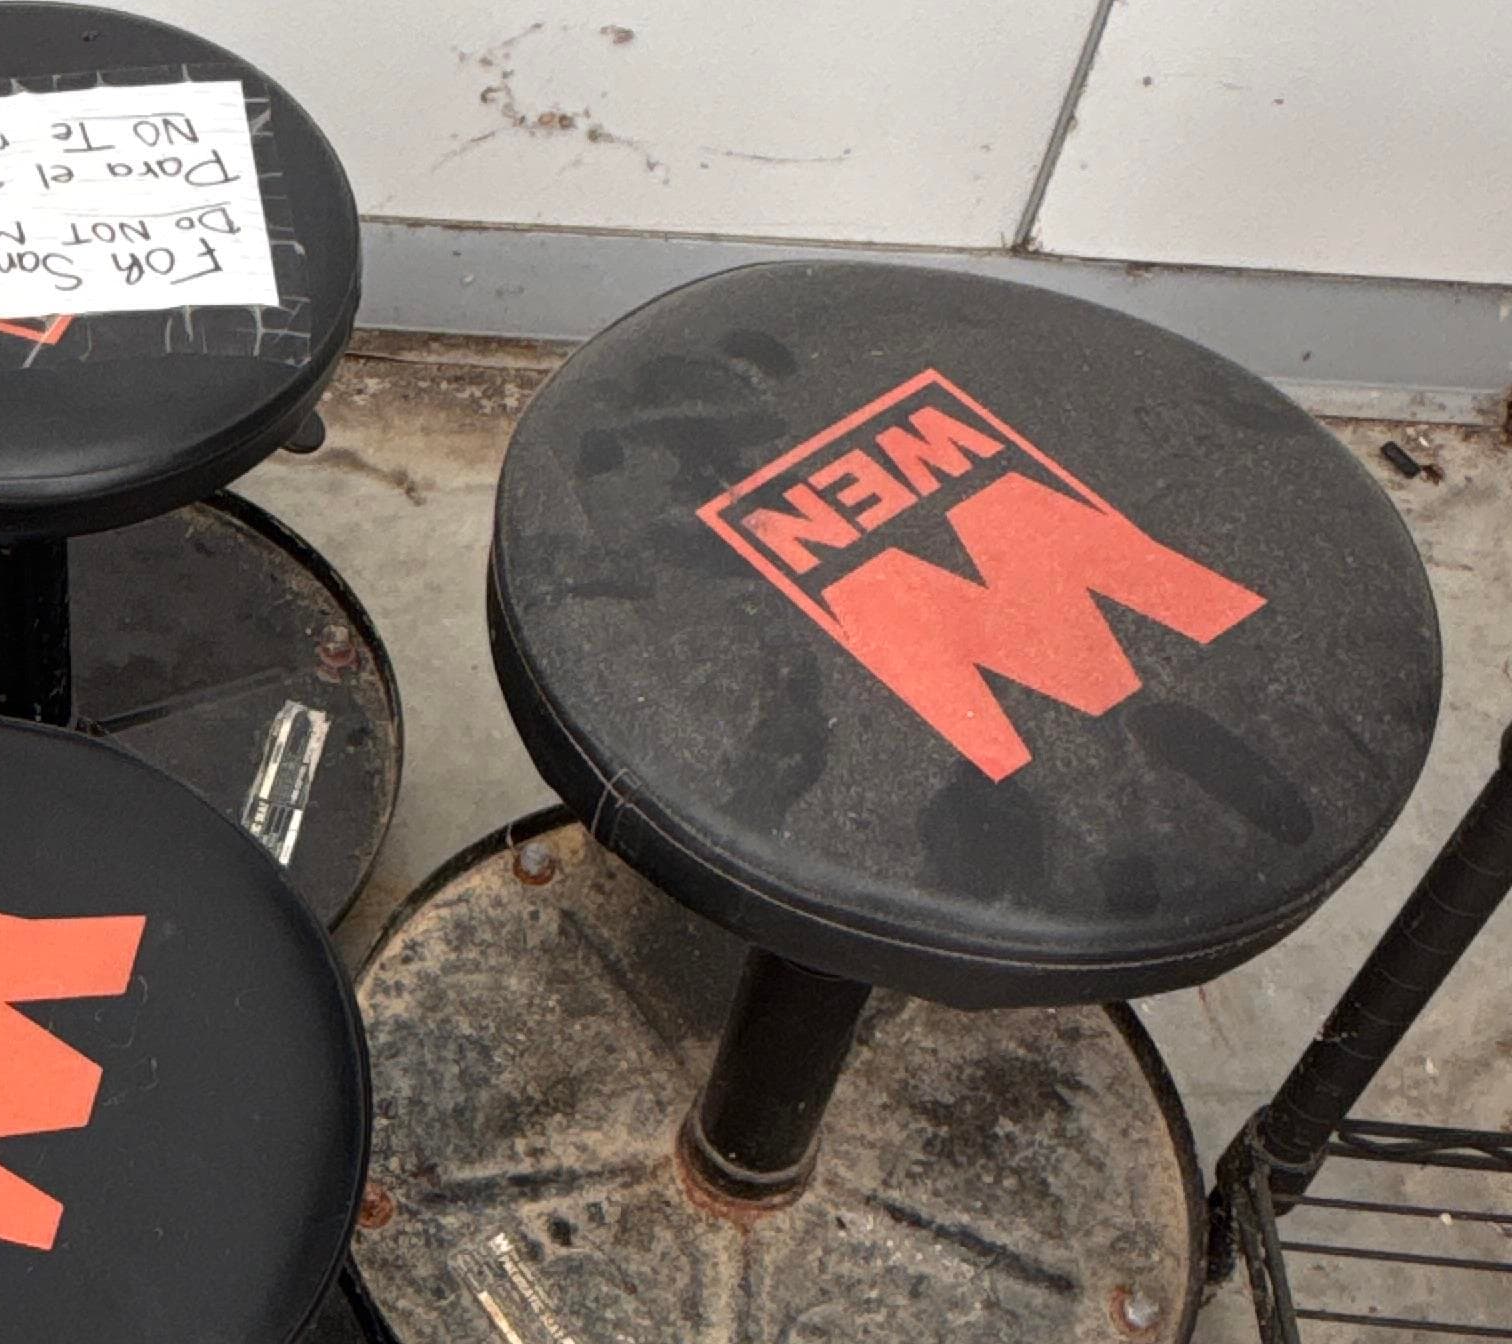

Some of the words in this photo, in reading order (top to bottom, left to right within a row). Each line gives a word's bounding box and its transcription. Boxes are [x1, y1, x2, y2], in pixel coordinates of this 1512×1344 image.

[50, 120, 116, 153] Te
[133, 117, 199, 145] NO
[36, 162, 75, 190] el
[106, 150, 241, 187] Para
[62, 218, 150, 246] NOT
[110, 238, 224, 285] FOR
[741, 405, 1005, 575] WEN
